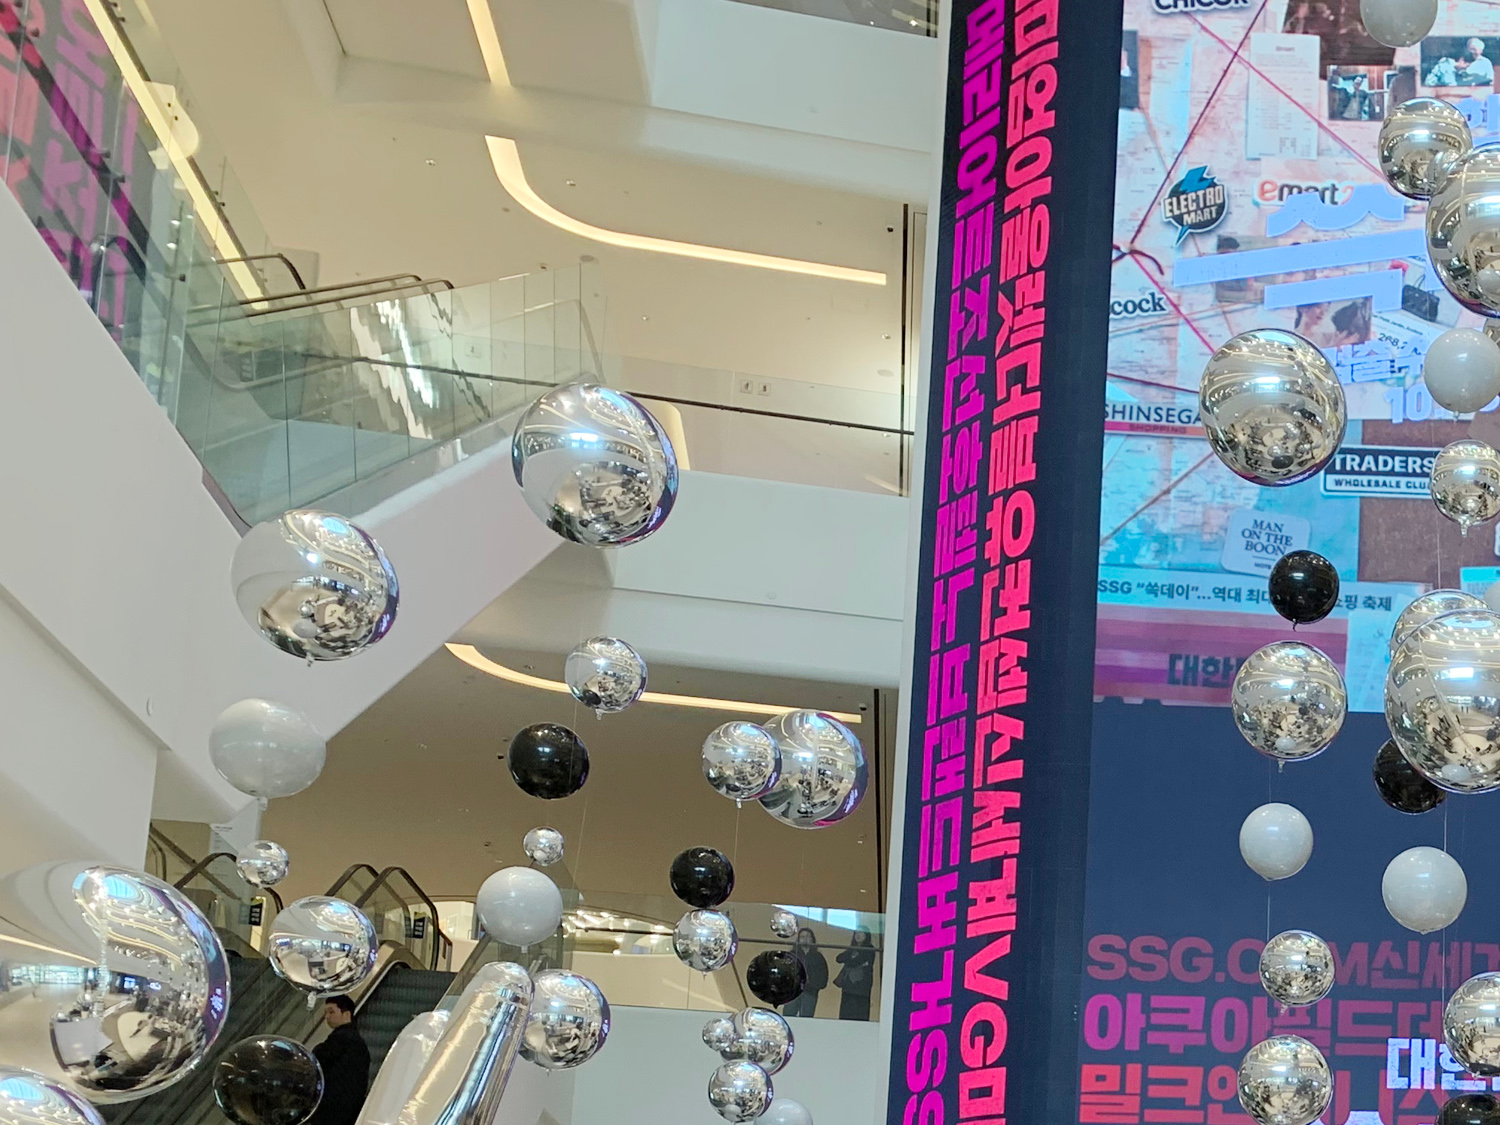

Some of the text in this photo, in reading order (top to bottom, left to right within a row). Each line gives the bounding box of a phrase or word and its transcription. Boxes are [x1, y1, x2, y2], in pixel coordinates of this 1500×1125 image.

[1164, 185, 1225, 218] ELECTRO
[1182, 207, 1218, 225] MART
[1333, 453, 1435, 473] TRADERS
[1334, 478, 1433, 490] WHOLESALE CLU
[1252, 518, 1285, 533] MAN
[1241, 528, 1293, 546] ON THE
[1244, 540, 1287, 556] BOON
[1098, 579, 1133, 594] SSG
[1362, 596, 1392, 612] 축제
